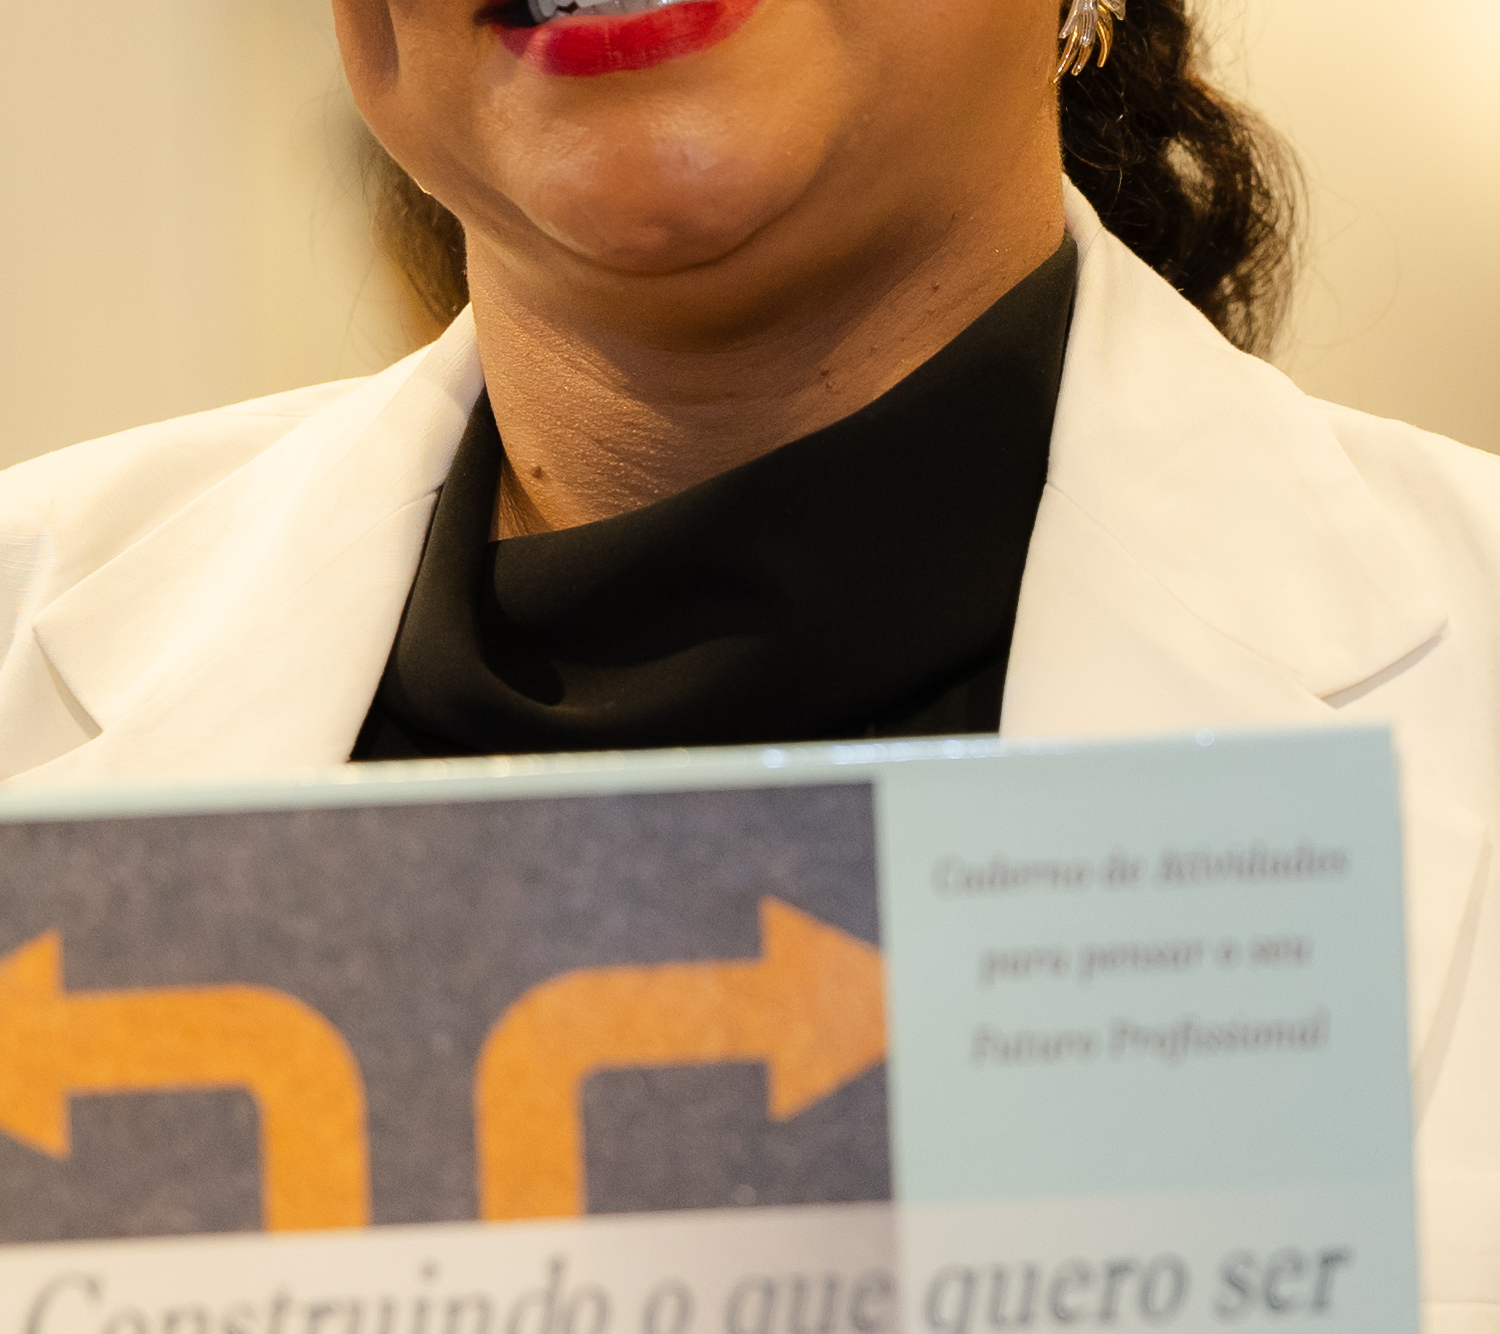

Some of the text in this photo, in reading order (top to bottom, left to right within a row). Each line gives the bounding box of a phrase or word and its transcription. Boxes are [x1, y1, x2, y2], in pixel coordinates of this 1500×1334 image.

[1104, 846, 1141, 889] de
[1155, 837, 1348, 888] Atividades
[1076, 939, 1203, 988] pensar
[1108, 1006, 1331, 1066] Profissional
[1213, 1246, 1353, 1322] ser
